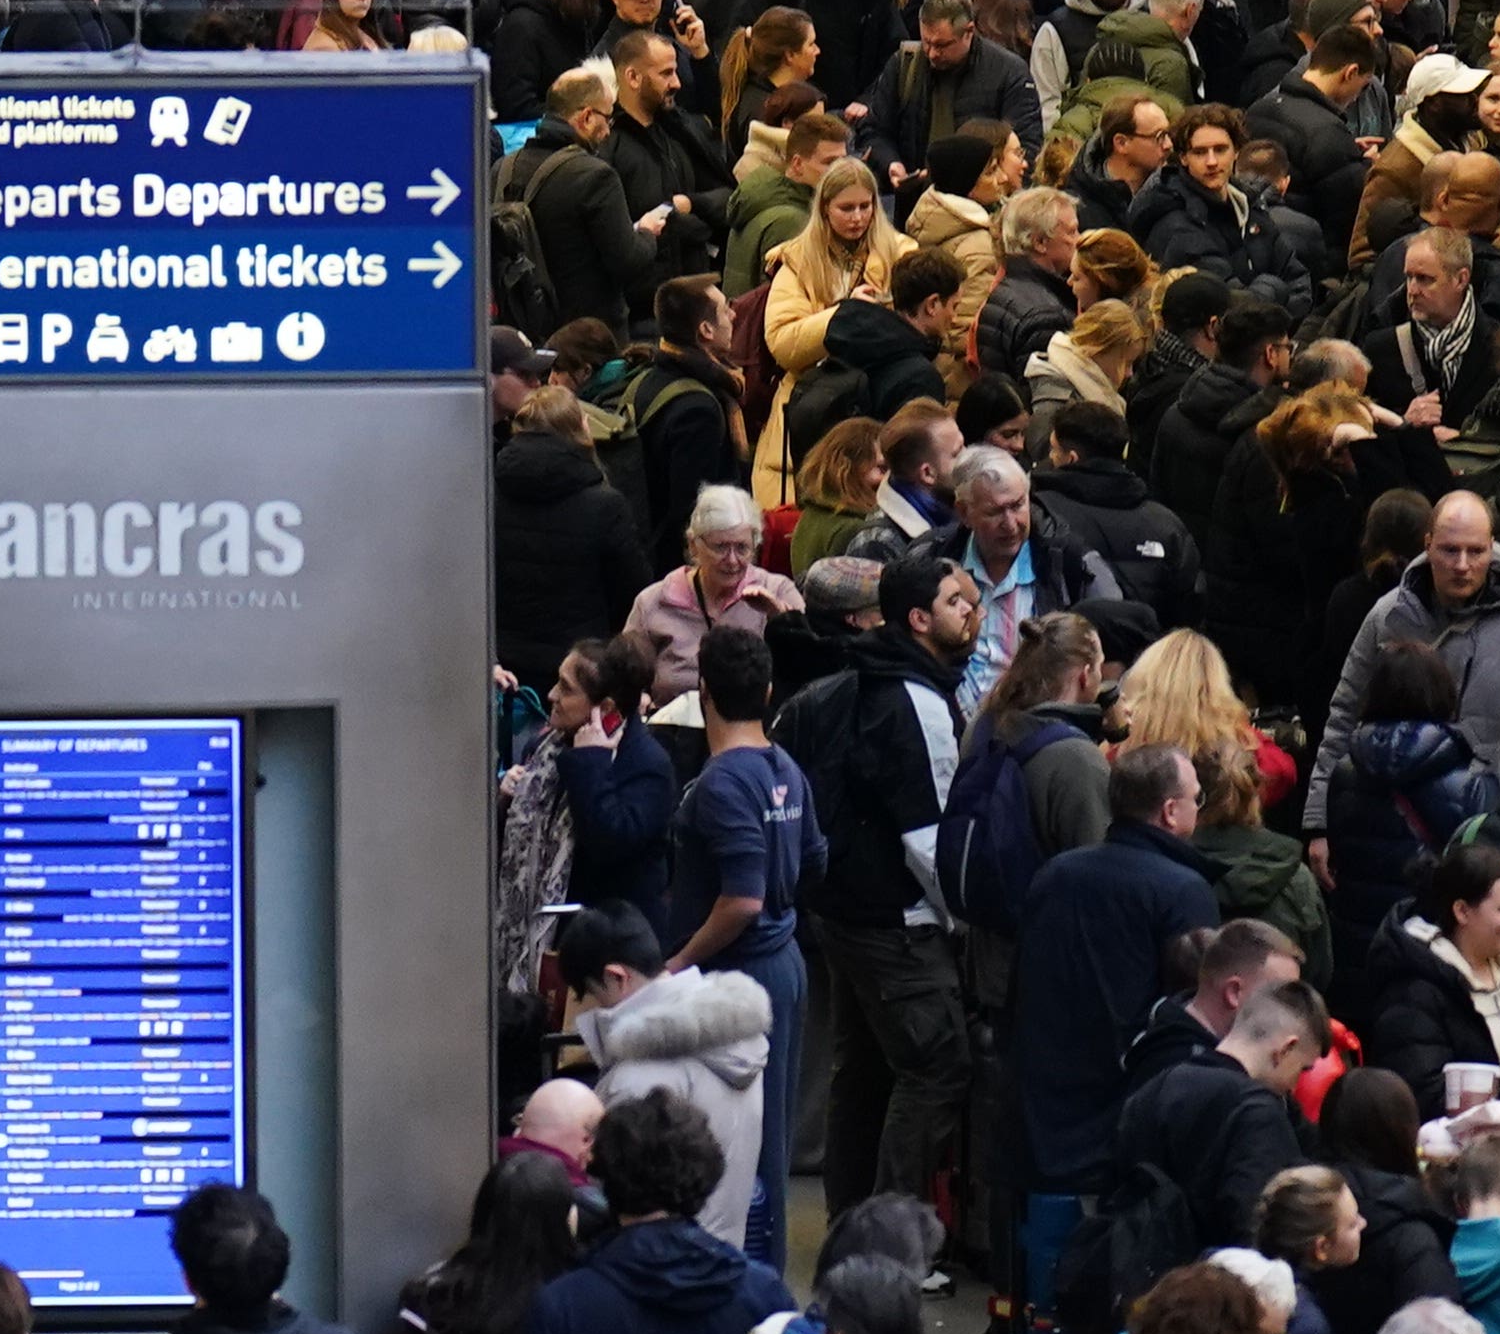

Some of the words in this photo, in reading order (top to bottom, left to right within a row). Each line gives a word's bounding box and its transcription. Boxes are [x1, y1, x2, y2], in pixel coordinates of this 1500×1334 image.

[63, 96, 135, 119] tickets
[14, 120, 118, 148] platforms
[134, 174, 385, 226] Departures
[236, 244, 387, 287] tickets
[72, 592, 304, 611] INTERNATIONAL
